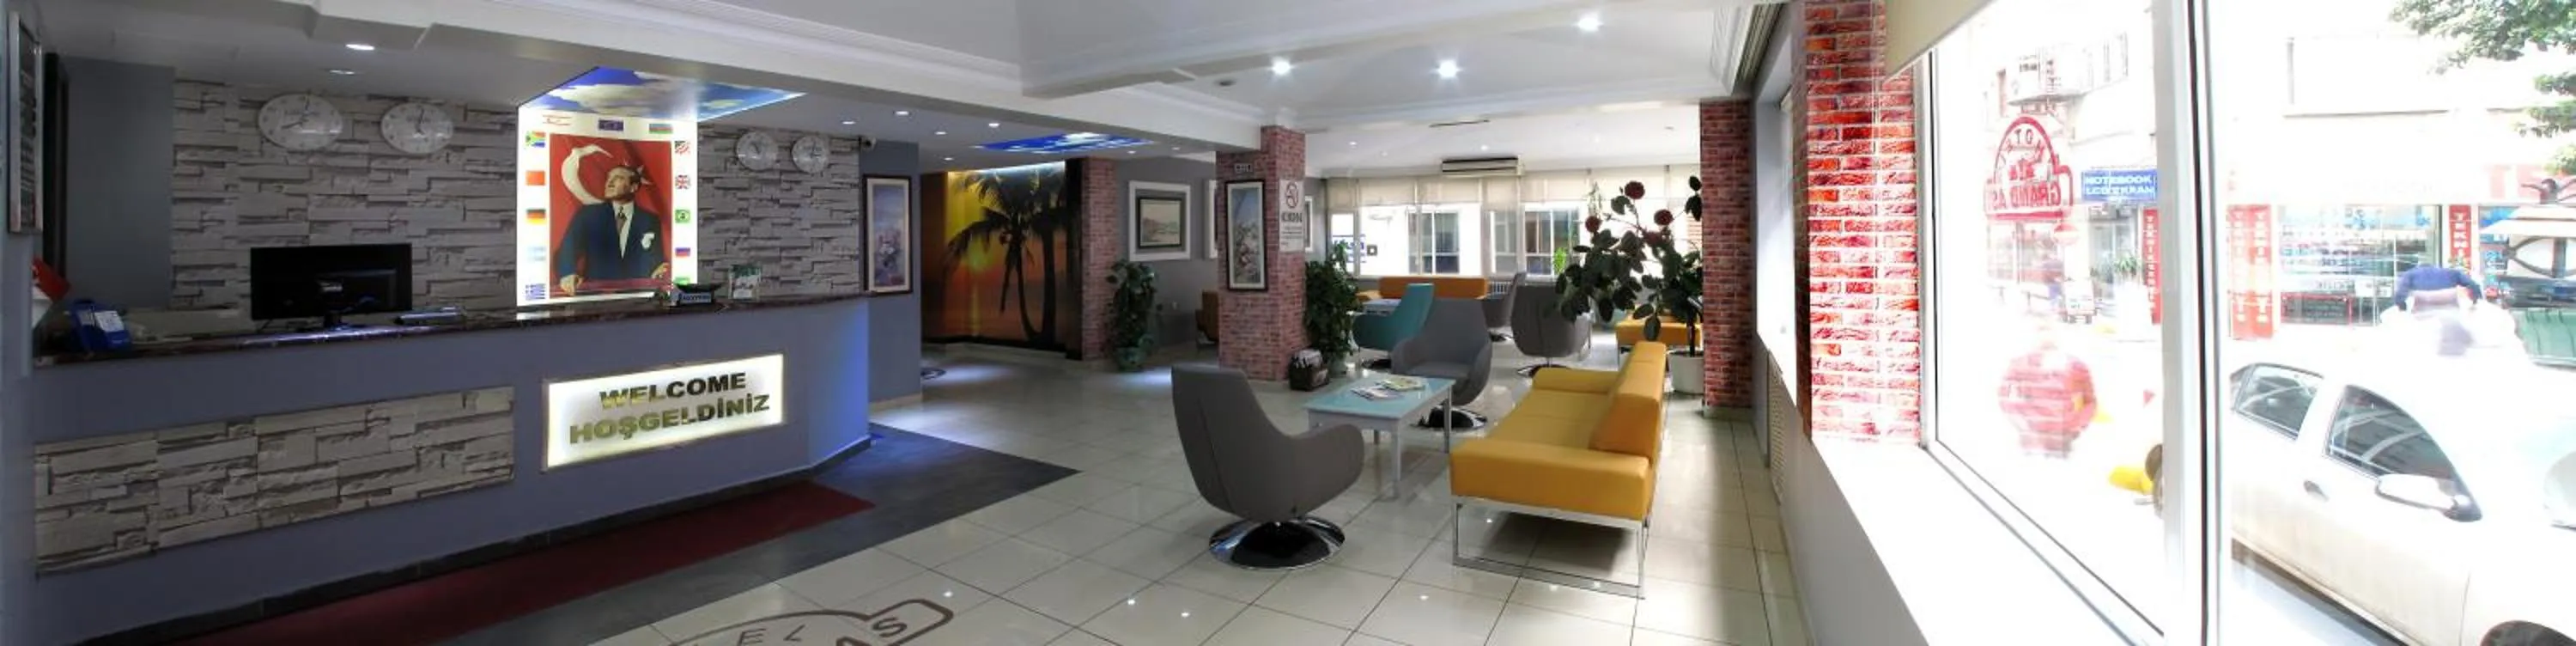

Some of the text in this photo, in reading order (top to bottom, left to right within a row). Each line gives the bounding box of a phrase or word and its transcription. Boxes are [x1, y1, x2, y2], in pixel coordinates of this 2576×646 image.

[2086, 175, 2153, 185] NOTEBOOK
[599, 372, 746, 409] WELCOME
[569, 393, 770, 444] HOŞGELDİNİZ
